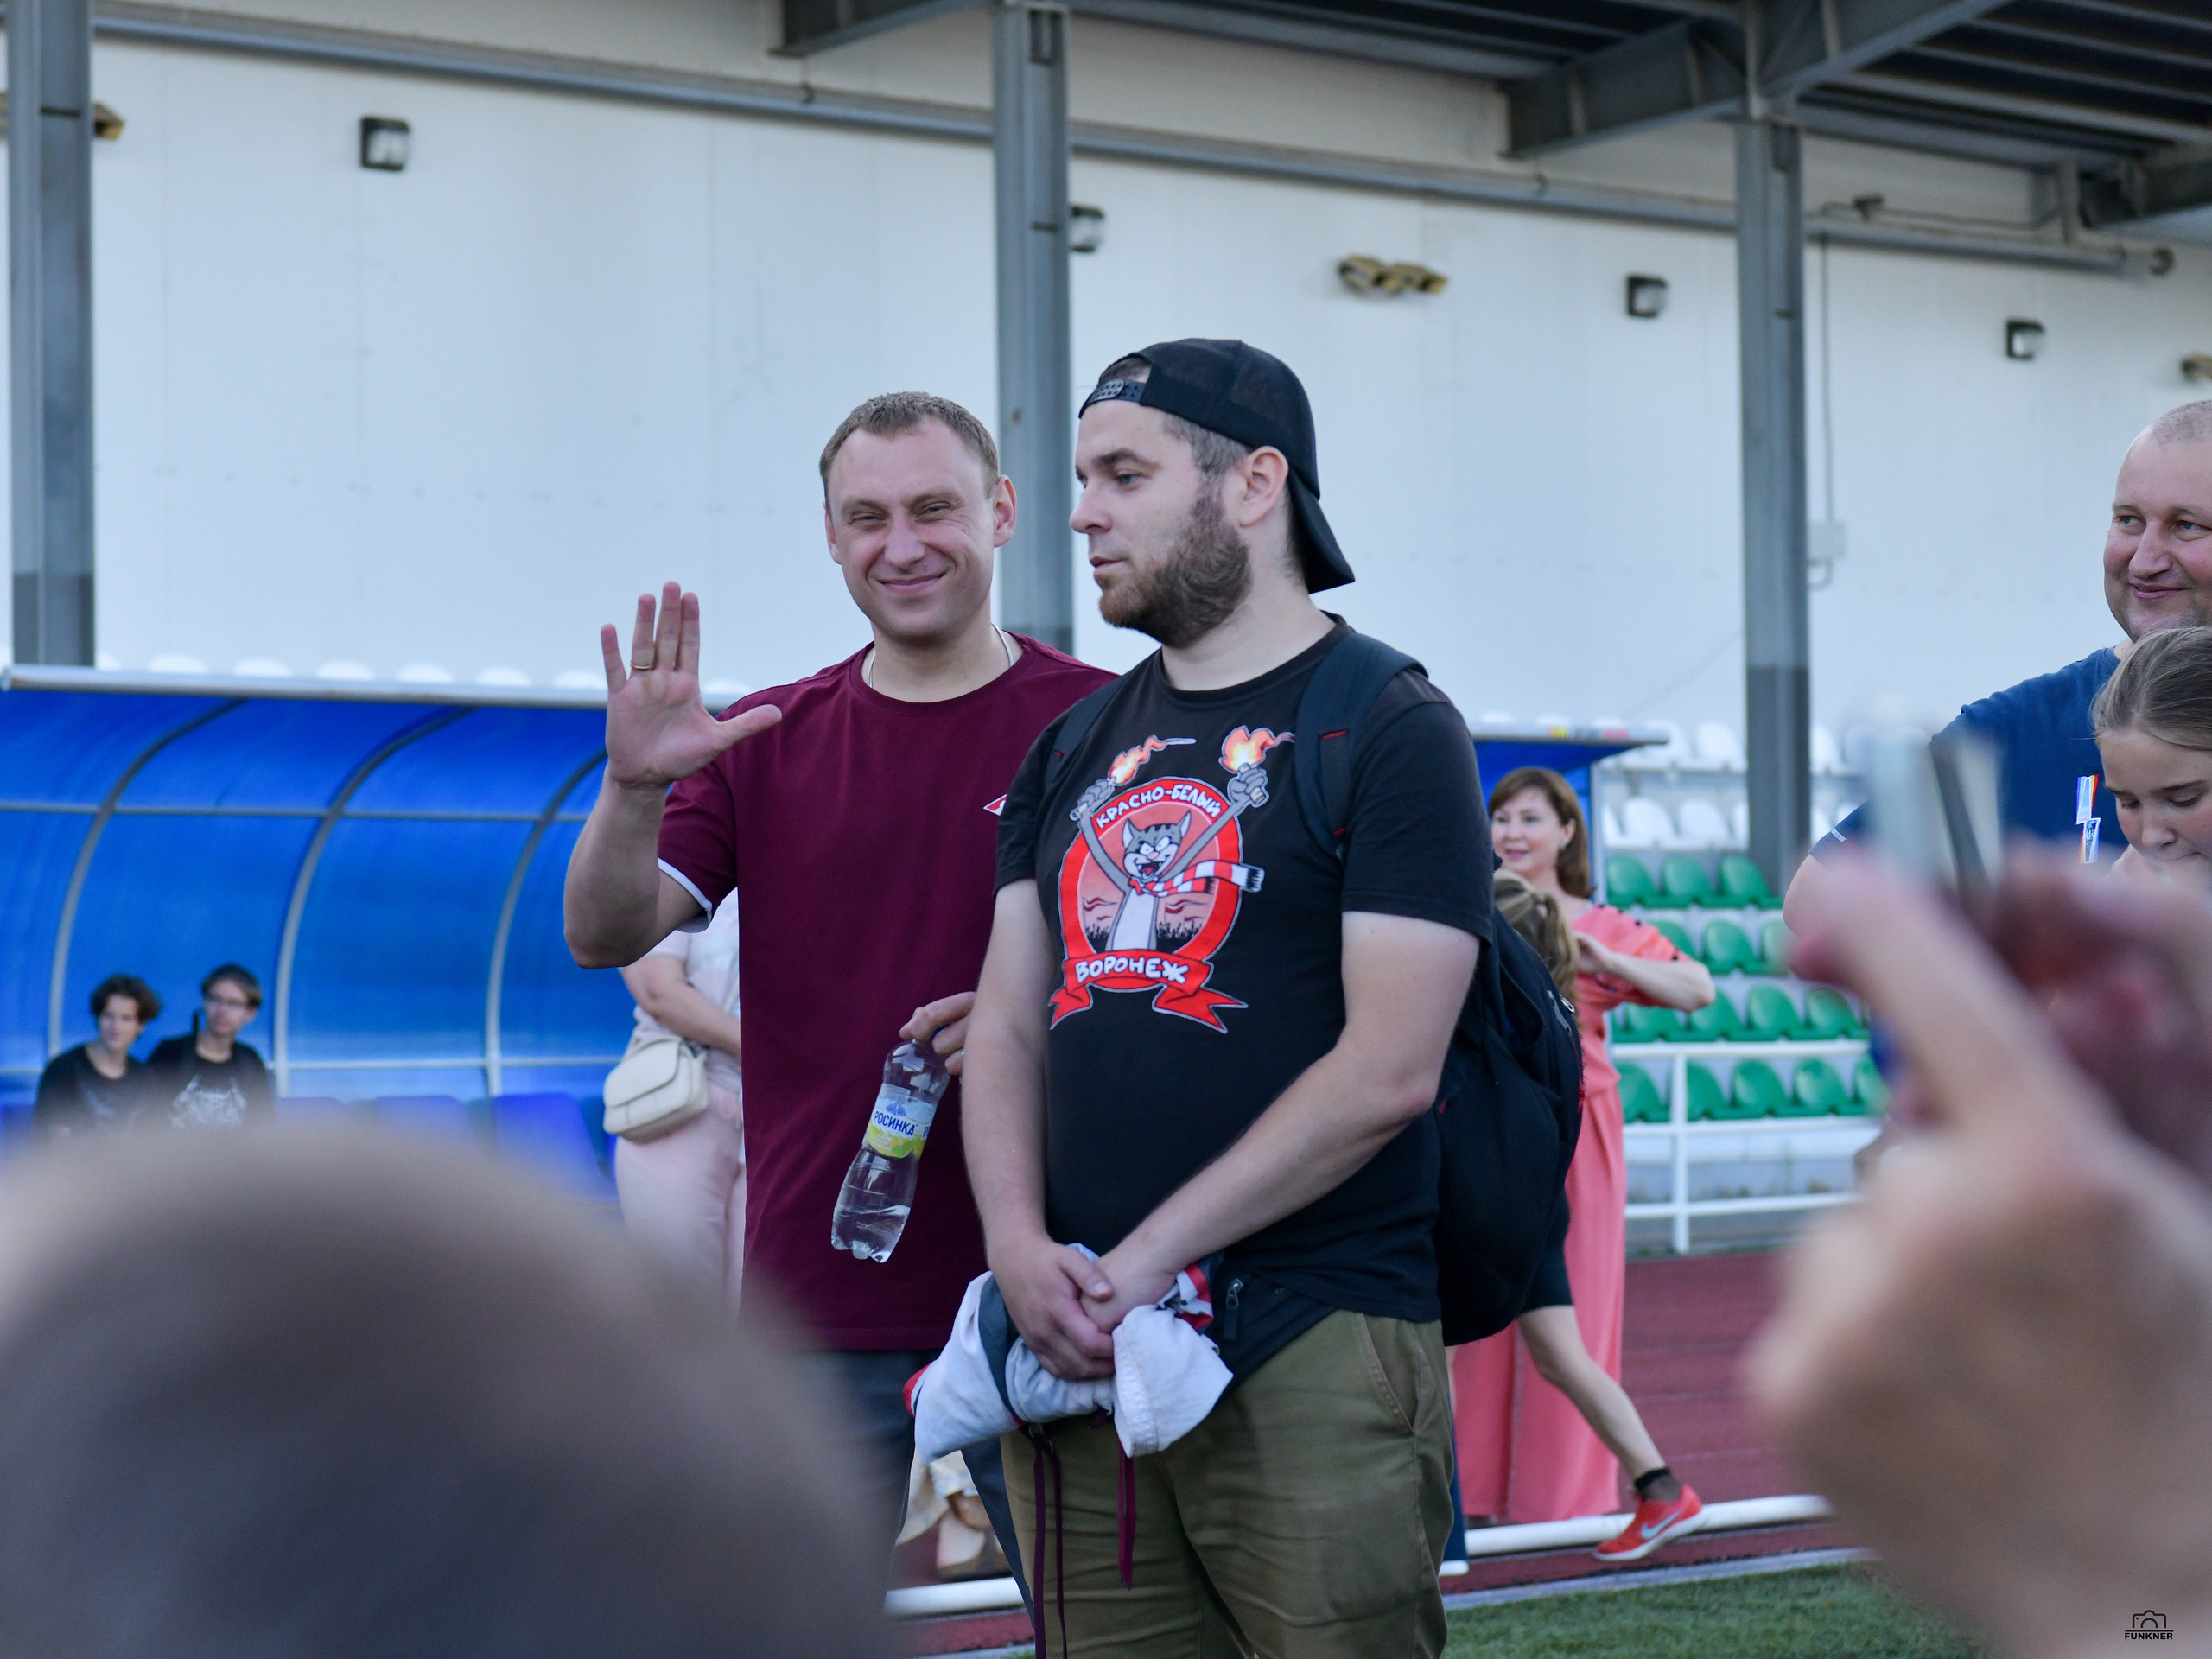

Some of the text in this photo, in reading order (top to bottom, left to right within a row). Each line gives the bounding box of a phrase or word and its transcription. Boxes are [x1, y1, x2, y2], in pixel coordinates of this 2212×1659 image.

[1096, 784, 1221, 829] КРАСНО-БЕЛЫЙ
[1075, 956, 1189, 984] ВОРОНЕЖ
[874, 1111, 915, 1136] РОСИНКА
